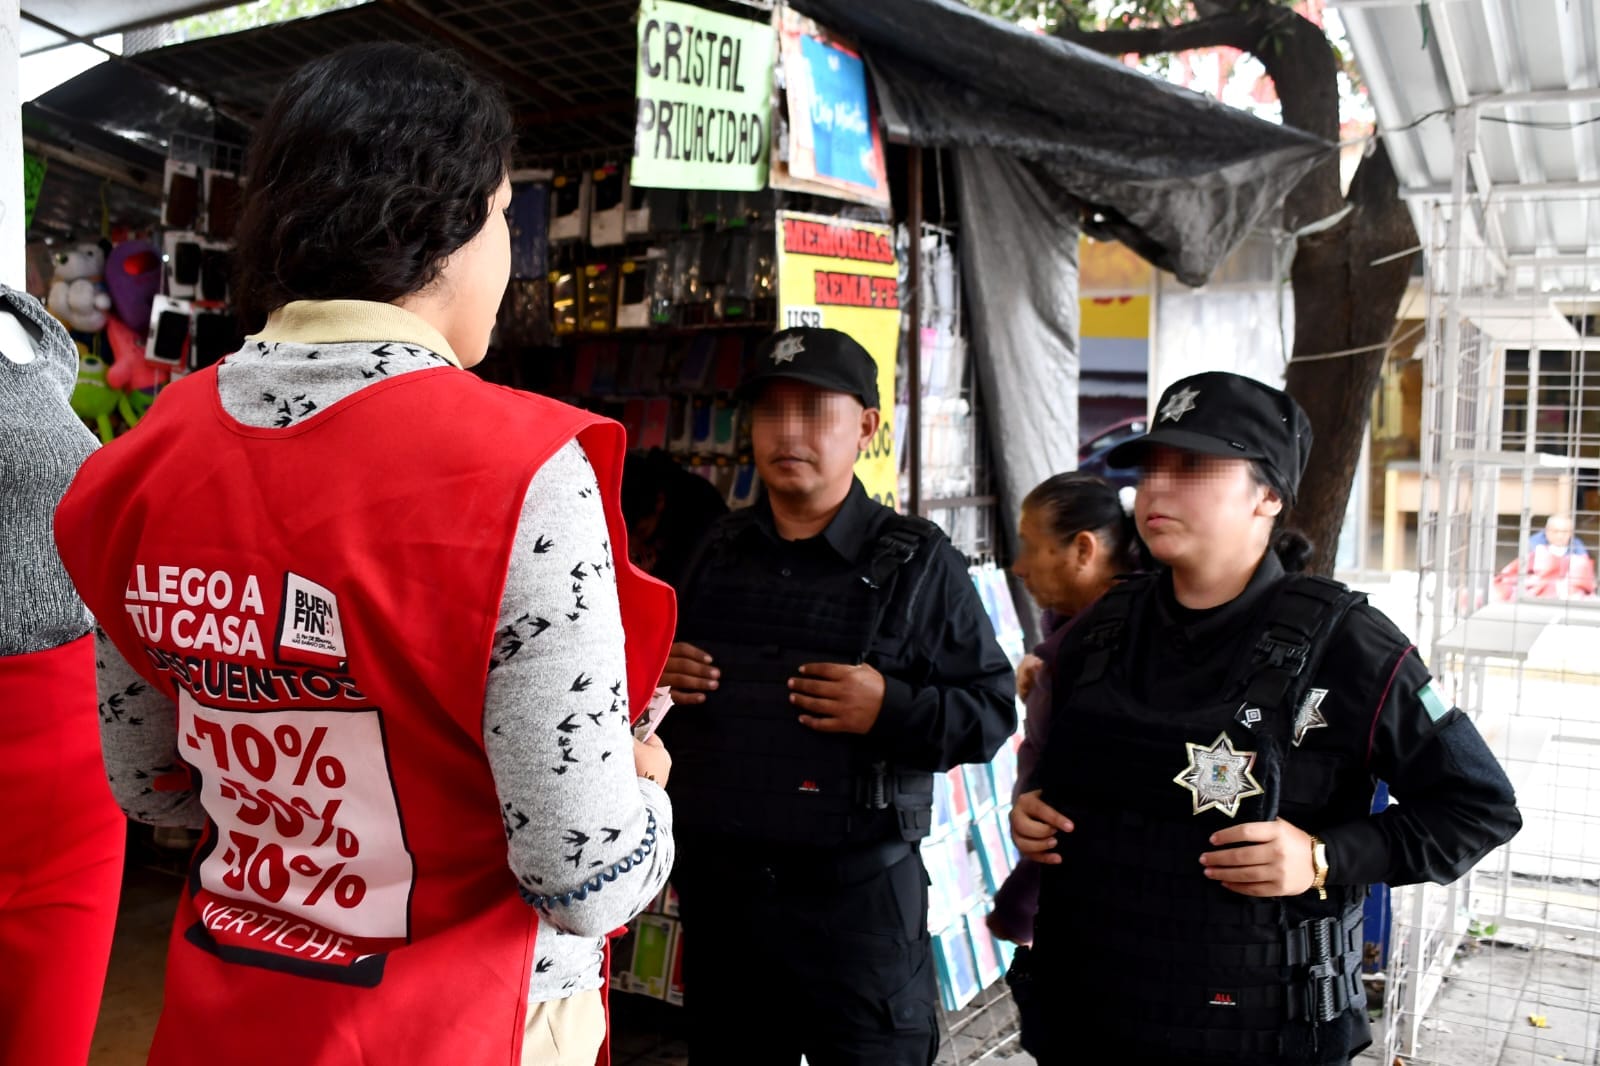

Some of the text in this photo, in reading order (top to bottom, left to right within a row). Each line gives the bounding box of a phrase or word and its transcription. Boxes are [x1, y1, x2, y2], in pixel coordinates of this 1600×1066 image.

[643, 19, 745, 93] CRISTAL
[784, 218, 895, 264] MEMORIAS
[814, 270, 899, 309] REMATE
[239, 574, 265, 615] A
[295, 589, 333, 619] BUEN
[124, 603, 266, 660] TU CASA
[186, 714, 346, 789] -70%
